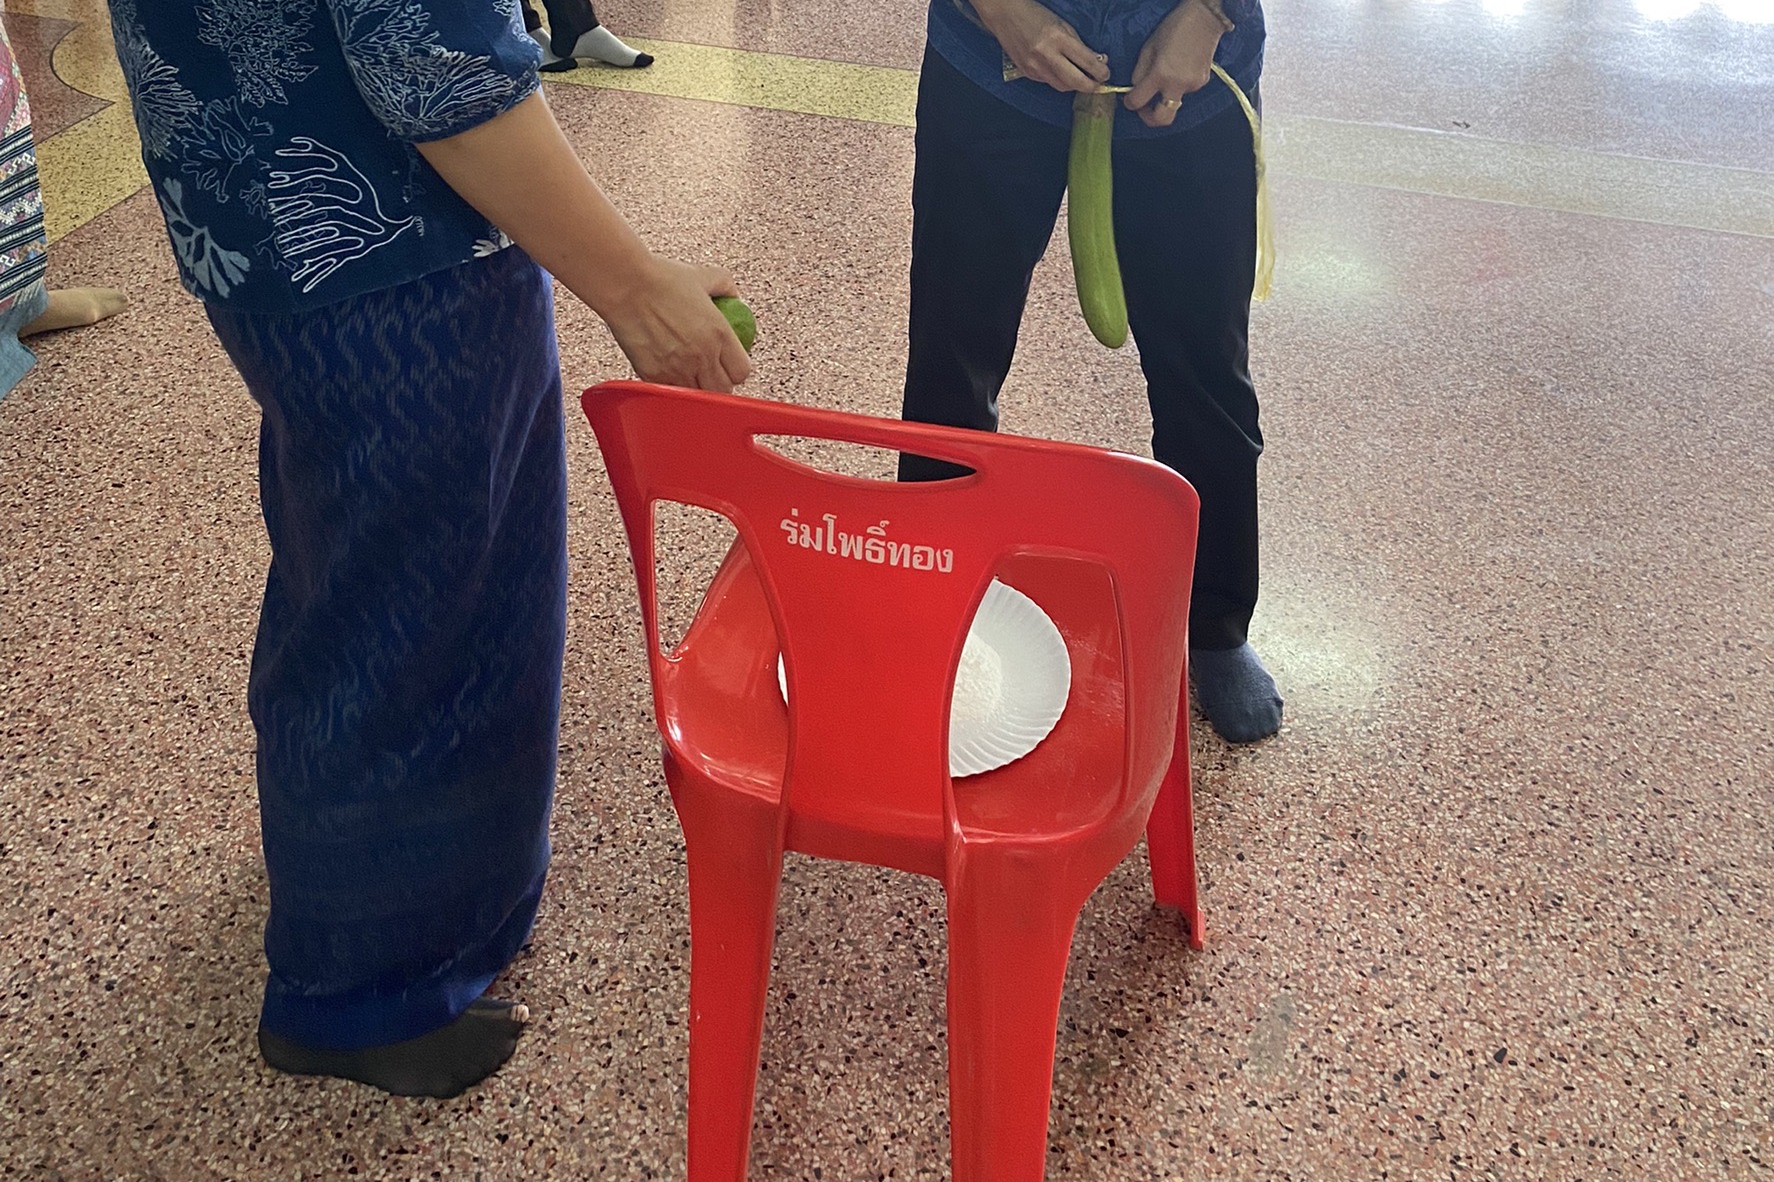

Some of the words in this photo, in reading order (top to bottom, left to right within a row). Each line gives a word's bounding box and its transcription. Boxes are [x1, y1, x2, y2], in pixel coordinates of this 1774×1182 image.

[780, 508, 954, 573] ร่มโพธิ์ทอง
